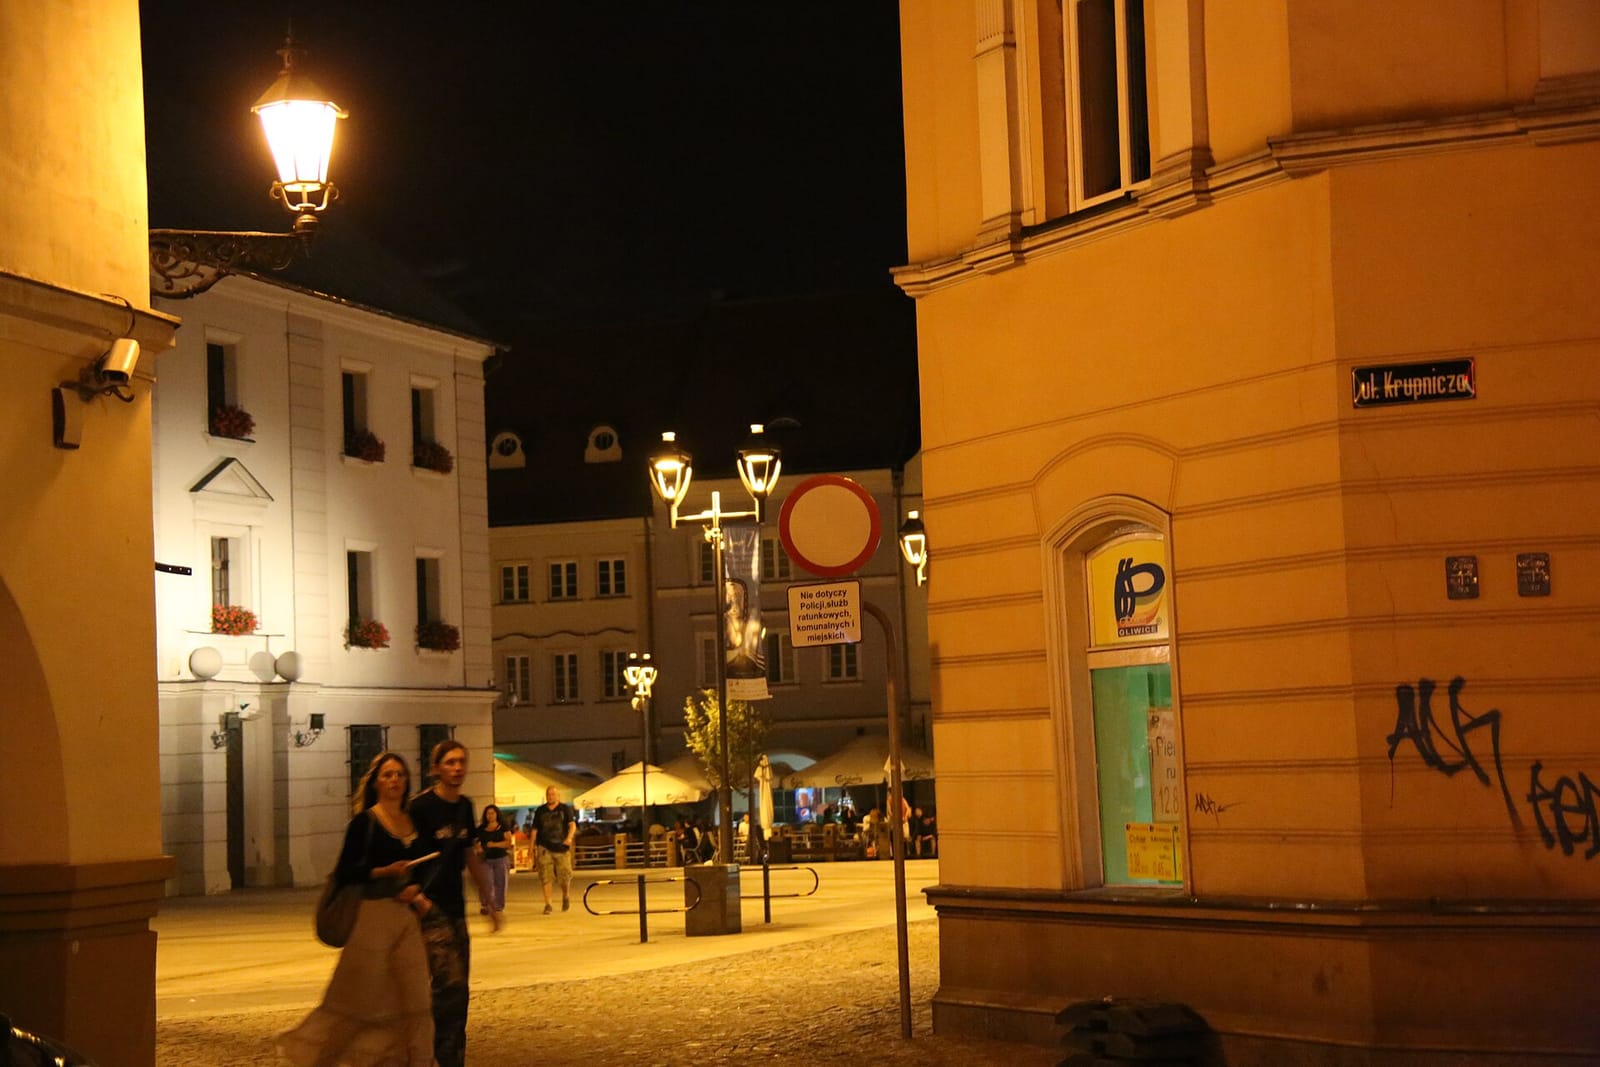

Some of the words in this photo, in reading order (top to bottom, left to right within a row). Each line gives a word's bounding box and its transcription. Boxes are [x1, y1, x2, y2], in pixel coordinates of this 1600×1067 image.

[800, 591, 814, 600] Nie
[815, 589, 848, 599] dotyczy
[798, 609, 852, 622] ratunkowych,
[796, 620, 850, 632] komunalnych
[807, 631, 845, 642] miejskich
